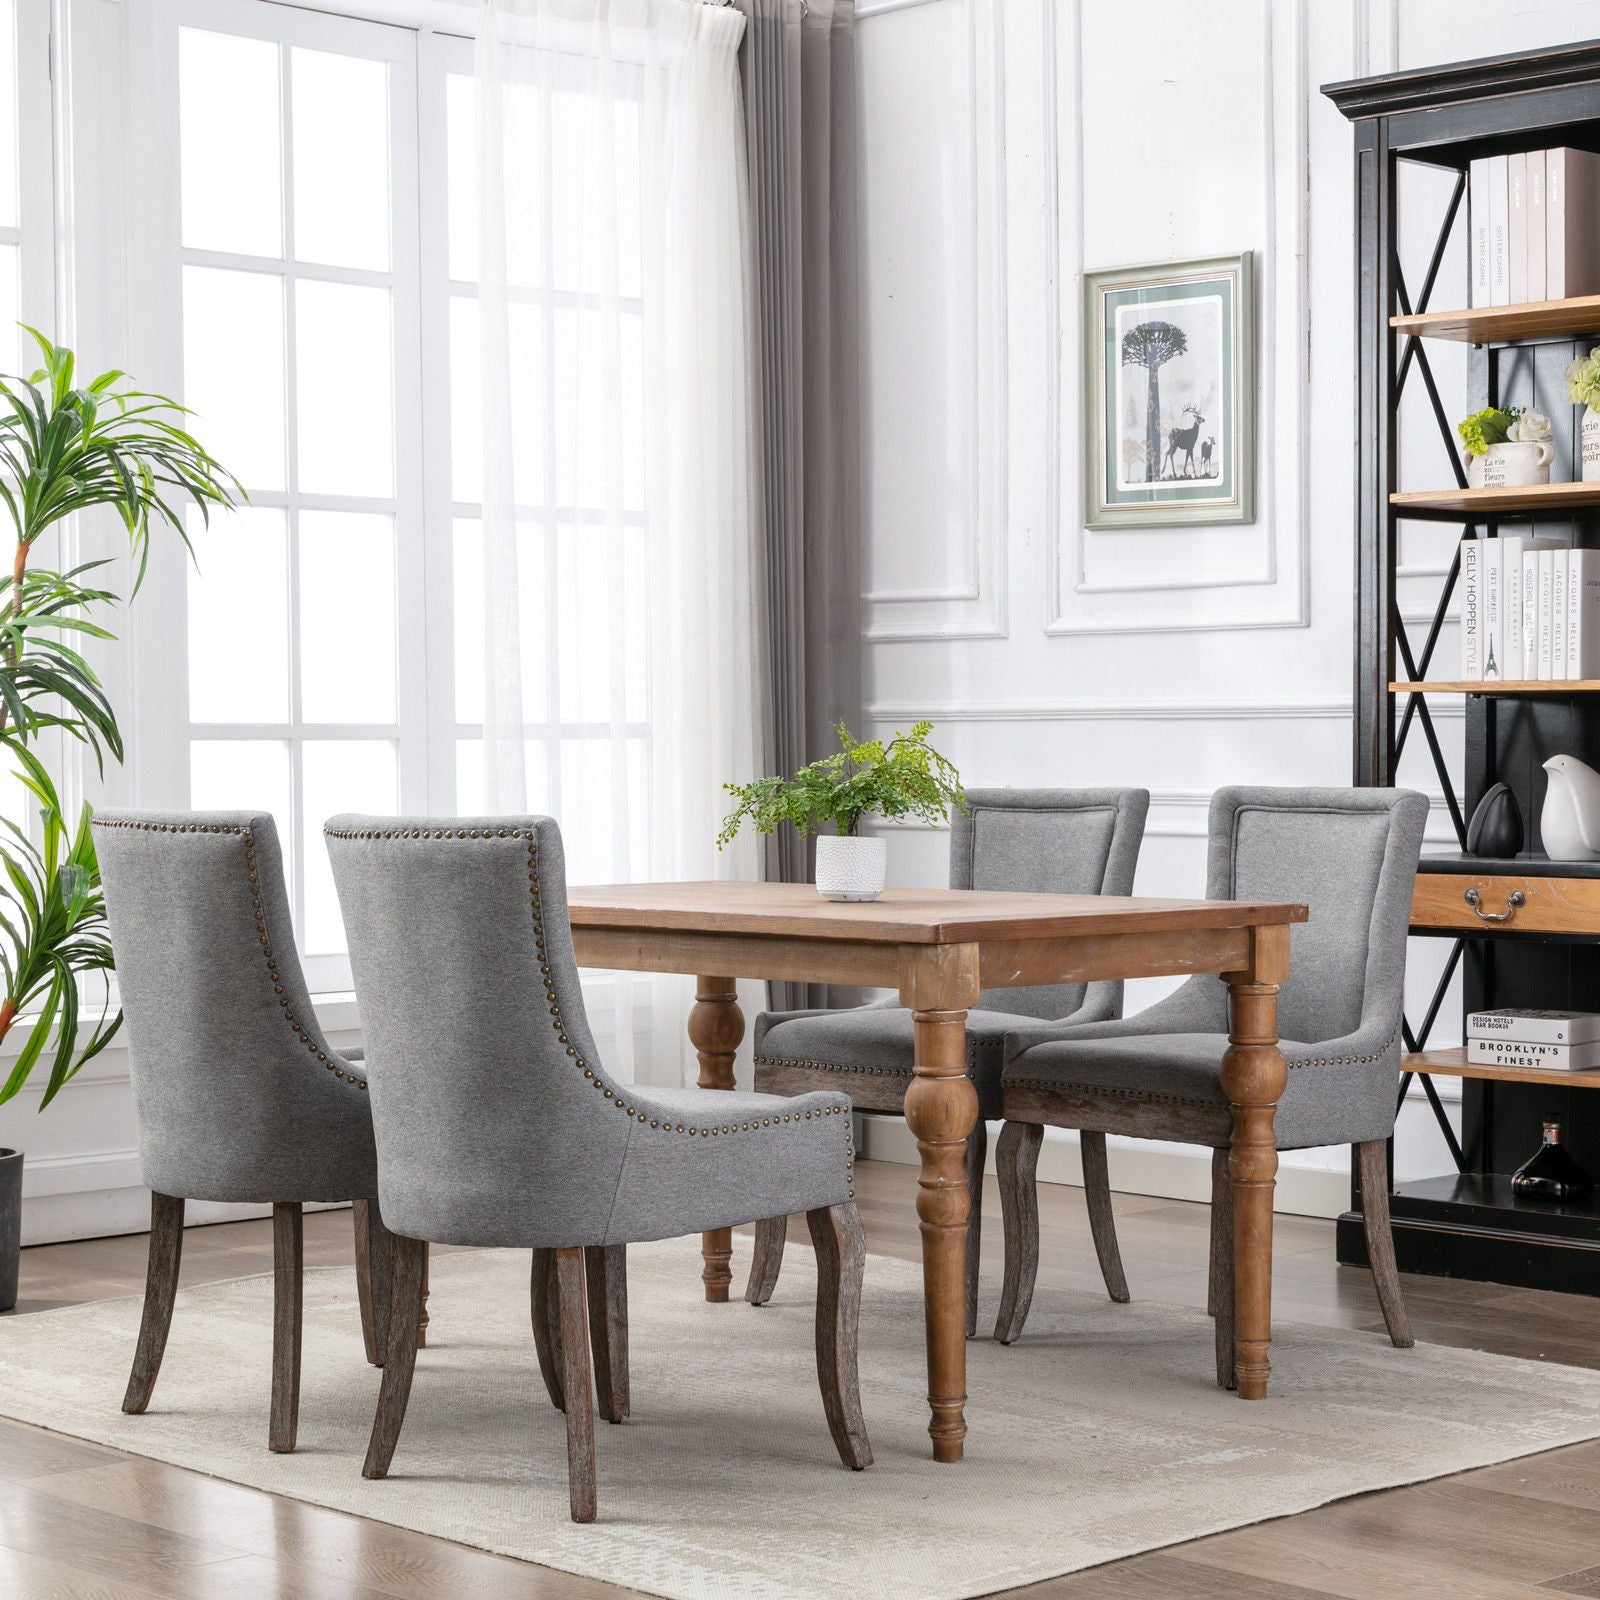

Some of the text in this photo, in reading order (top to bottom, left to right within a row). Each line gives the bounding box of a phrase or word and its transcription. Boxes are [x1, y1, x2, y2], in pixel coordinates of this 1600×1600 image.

[1525, 568, 1534, 609] HOUSEHOLD
[1466, 547, 1476, 674] KELLY HOPPEN STYLE
[1569, 622, 1577, 661] HELLEU
[1479, 1042, 1559, 1056] BROOKLYN'S
[1496, 1056, 1542, 1066] FINEST
